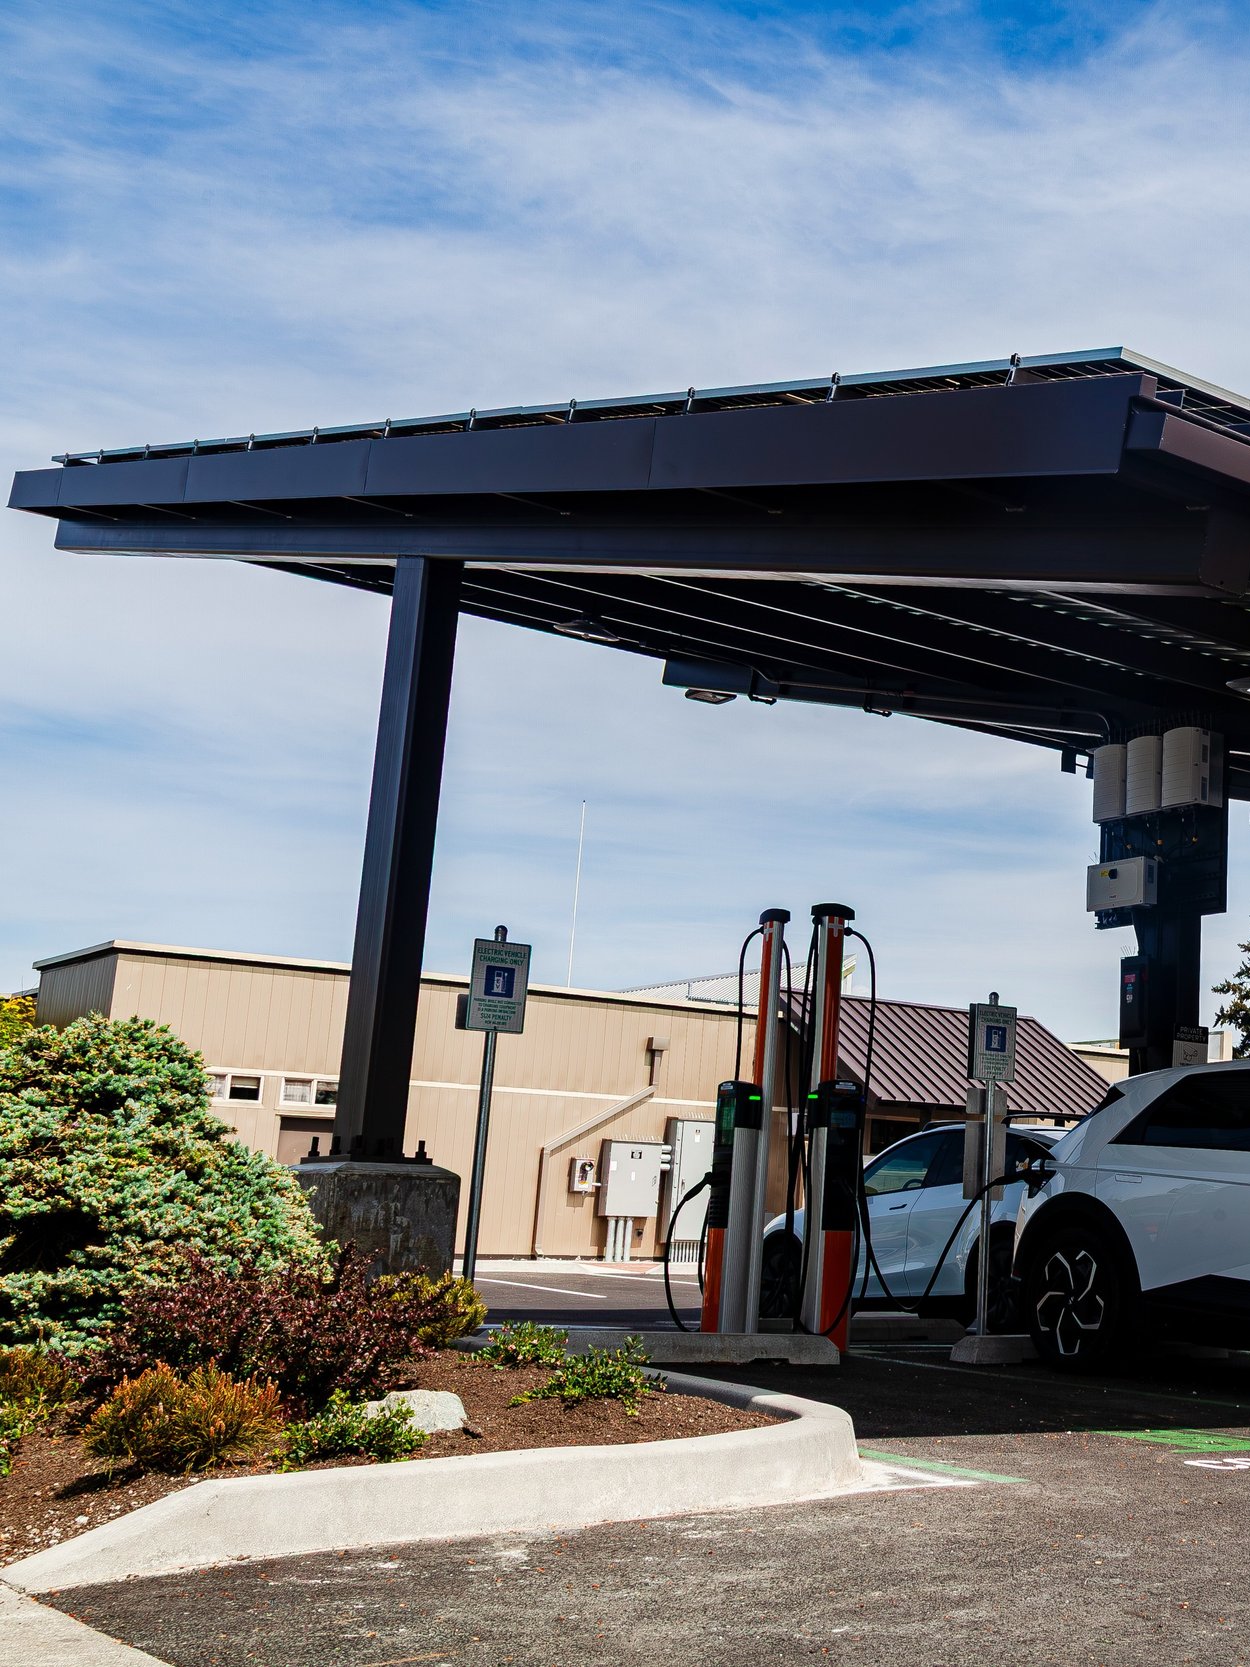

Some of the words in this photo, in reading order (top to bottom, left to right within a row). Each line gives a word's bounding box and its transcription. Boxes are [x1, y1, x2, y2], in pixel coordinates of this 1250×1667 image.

[478, 948, 503, 957] ELECTRIC
[503, 950, 527, 959] VEHICLE
[480, 955, 508, 964] CHARGING
[509, 958, 524, 966] ONLY
[1180, 1026, 1203, 1035] PRIVATE
[1176, 1032, 1206, 1042] PROPERTY
